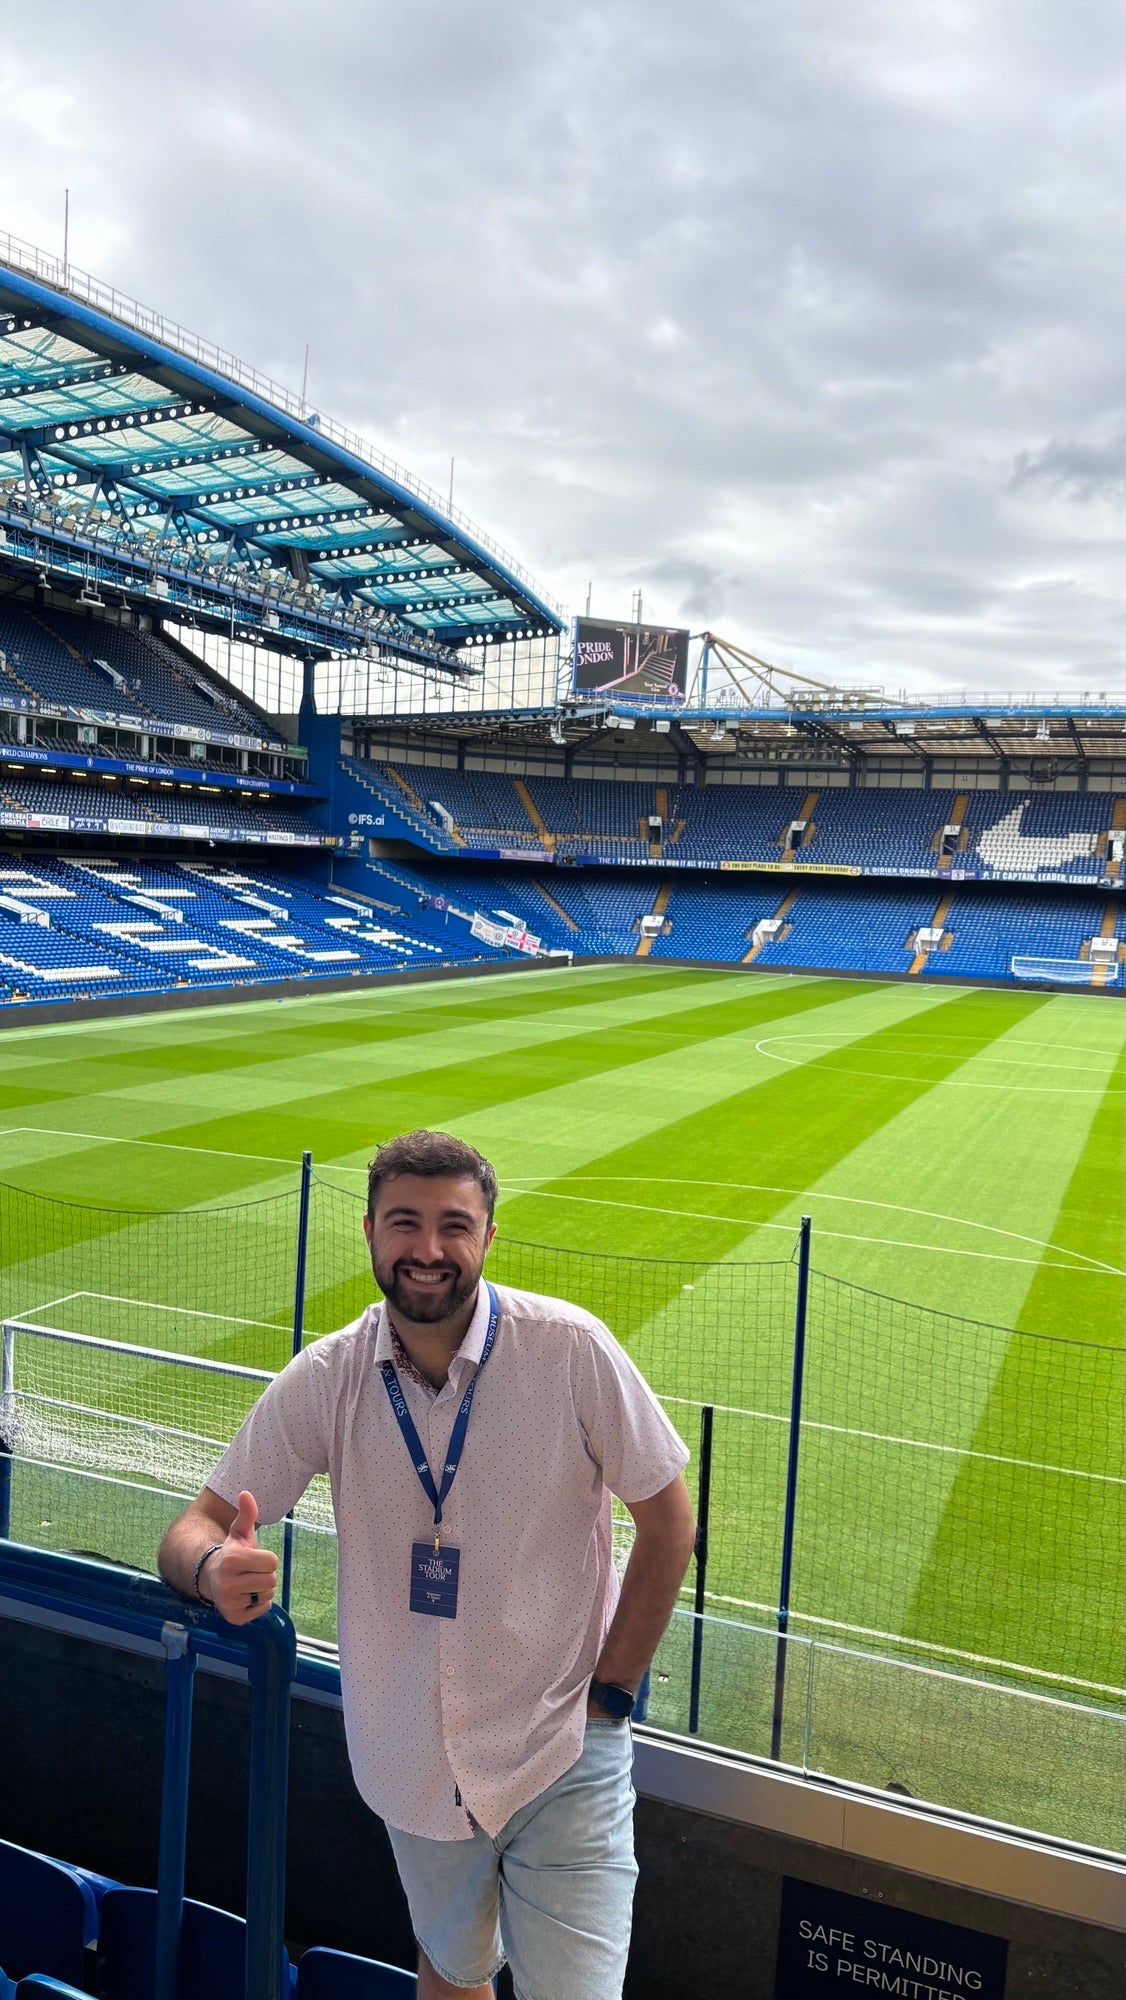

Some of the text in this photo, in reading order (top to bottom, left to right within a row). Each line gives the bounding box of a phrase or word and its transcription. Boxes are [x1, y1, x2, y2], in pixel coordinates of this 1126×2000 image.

[578, 642, 611, 654] PRIDE
[577, 651, 613, 666] ONDON
[17, 750, 48, 760] CHAMPIONS
[126, 763, 135, 771] THE
[135, 764, 148, 773] PRIDE
[156, 767, 174, 775] LONDON
[0, 812, 26, 820] CHELSEA
[358, 814, 385, 826] IFS.ai
[992, 871, 1098, 885] JT CAPTAIN, LEADER, LEGEND
[481, 1313, 498, 1361] MUSEUM
[387, 1378, 408, 1417] TOURS
[461, 1382, 475, 1414] OURS
[418, 1563, 452, 1576] STADIUM
[428, 1558, 443, 1568] THE
[424, 1570, 446, 1581] TOUR
[798, 1920, 982, 1990] SAFE STANDING
[807, 1950, 829, 1972] IS
